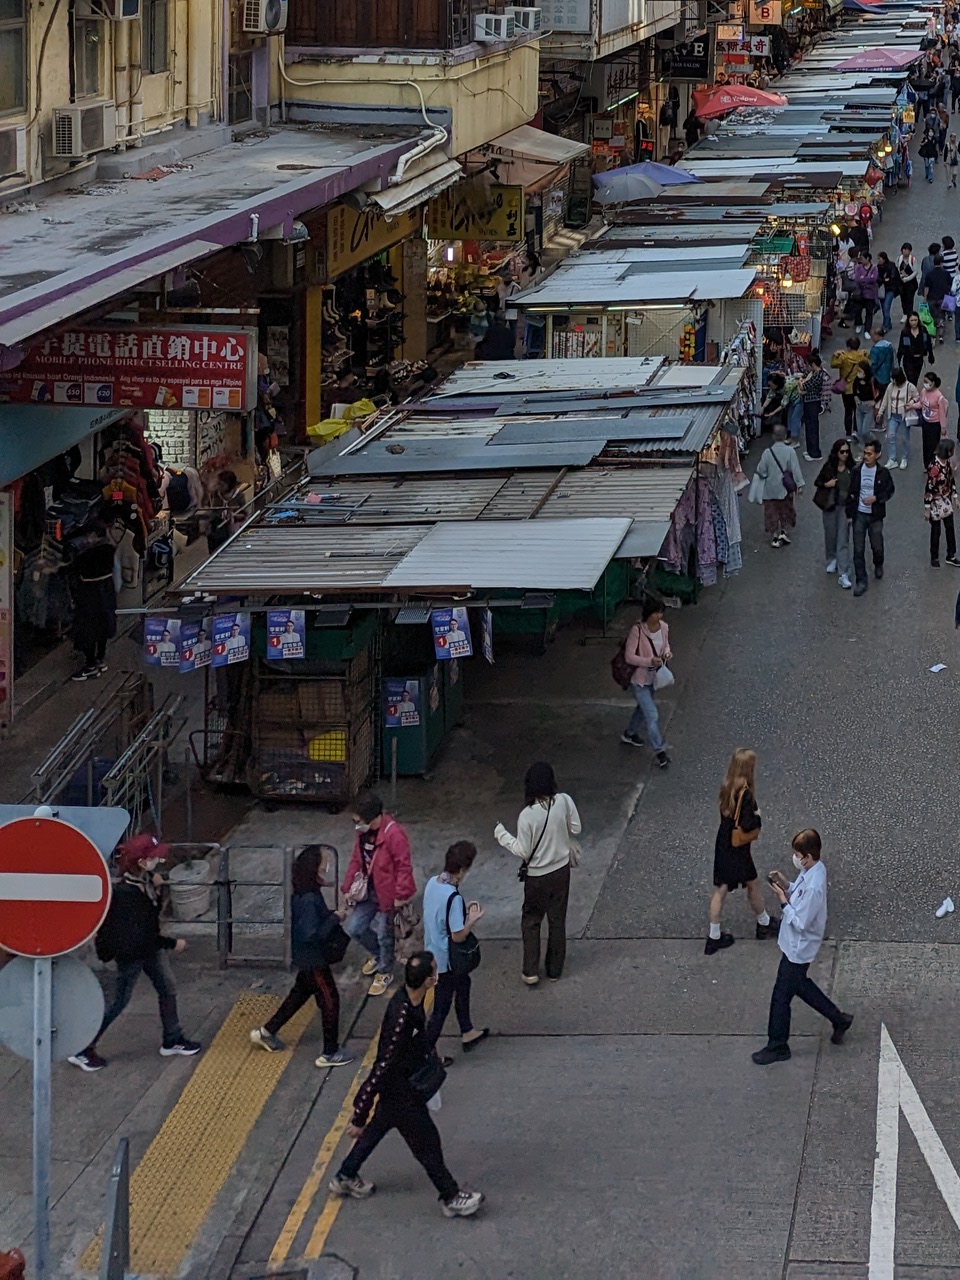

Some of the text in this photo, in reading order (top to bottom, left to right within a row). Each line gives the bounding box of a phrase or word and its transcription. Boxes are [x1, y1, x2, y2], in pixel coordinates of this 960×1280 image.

[761, 7, 770, 18] B
[35, 355, 243, 370] MOBILE PHONE DIRECT SELLING CENTRE
[63, 374, 82, 382] Orang
